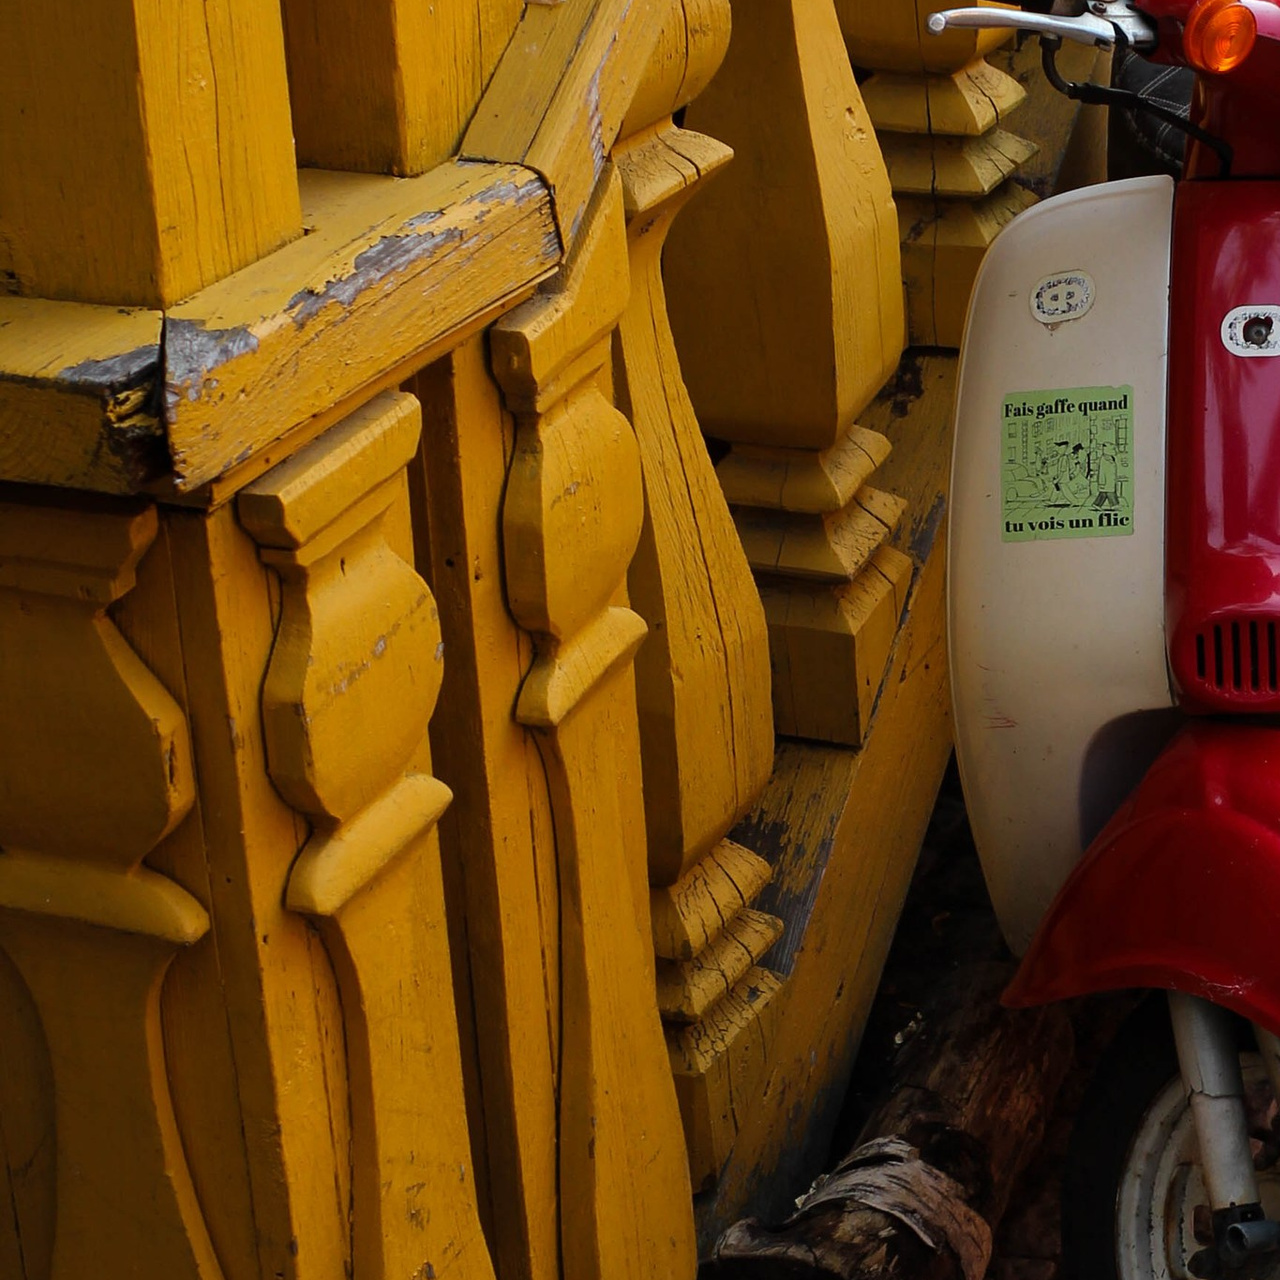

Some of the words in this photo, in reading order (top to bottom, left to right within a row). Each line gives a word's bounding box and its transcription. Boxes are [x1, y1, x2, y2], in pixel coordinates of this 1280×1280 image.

[1005, 402, 1034, 418] Fais
[1036, 399, 1075, 419] gaffe
[1078, 395, 1128, 416] quand
[1005, 520, 1024, 533] tu
[1027, 516, 1065, 531] vois
[1069, 517, 1094, 529] un
[1098, 512, 1130, 527] flic
